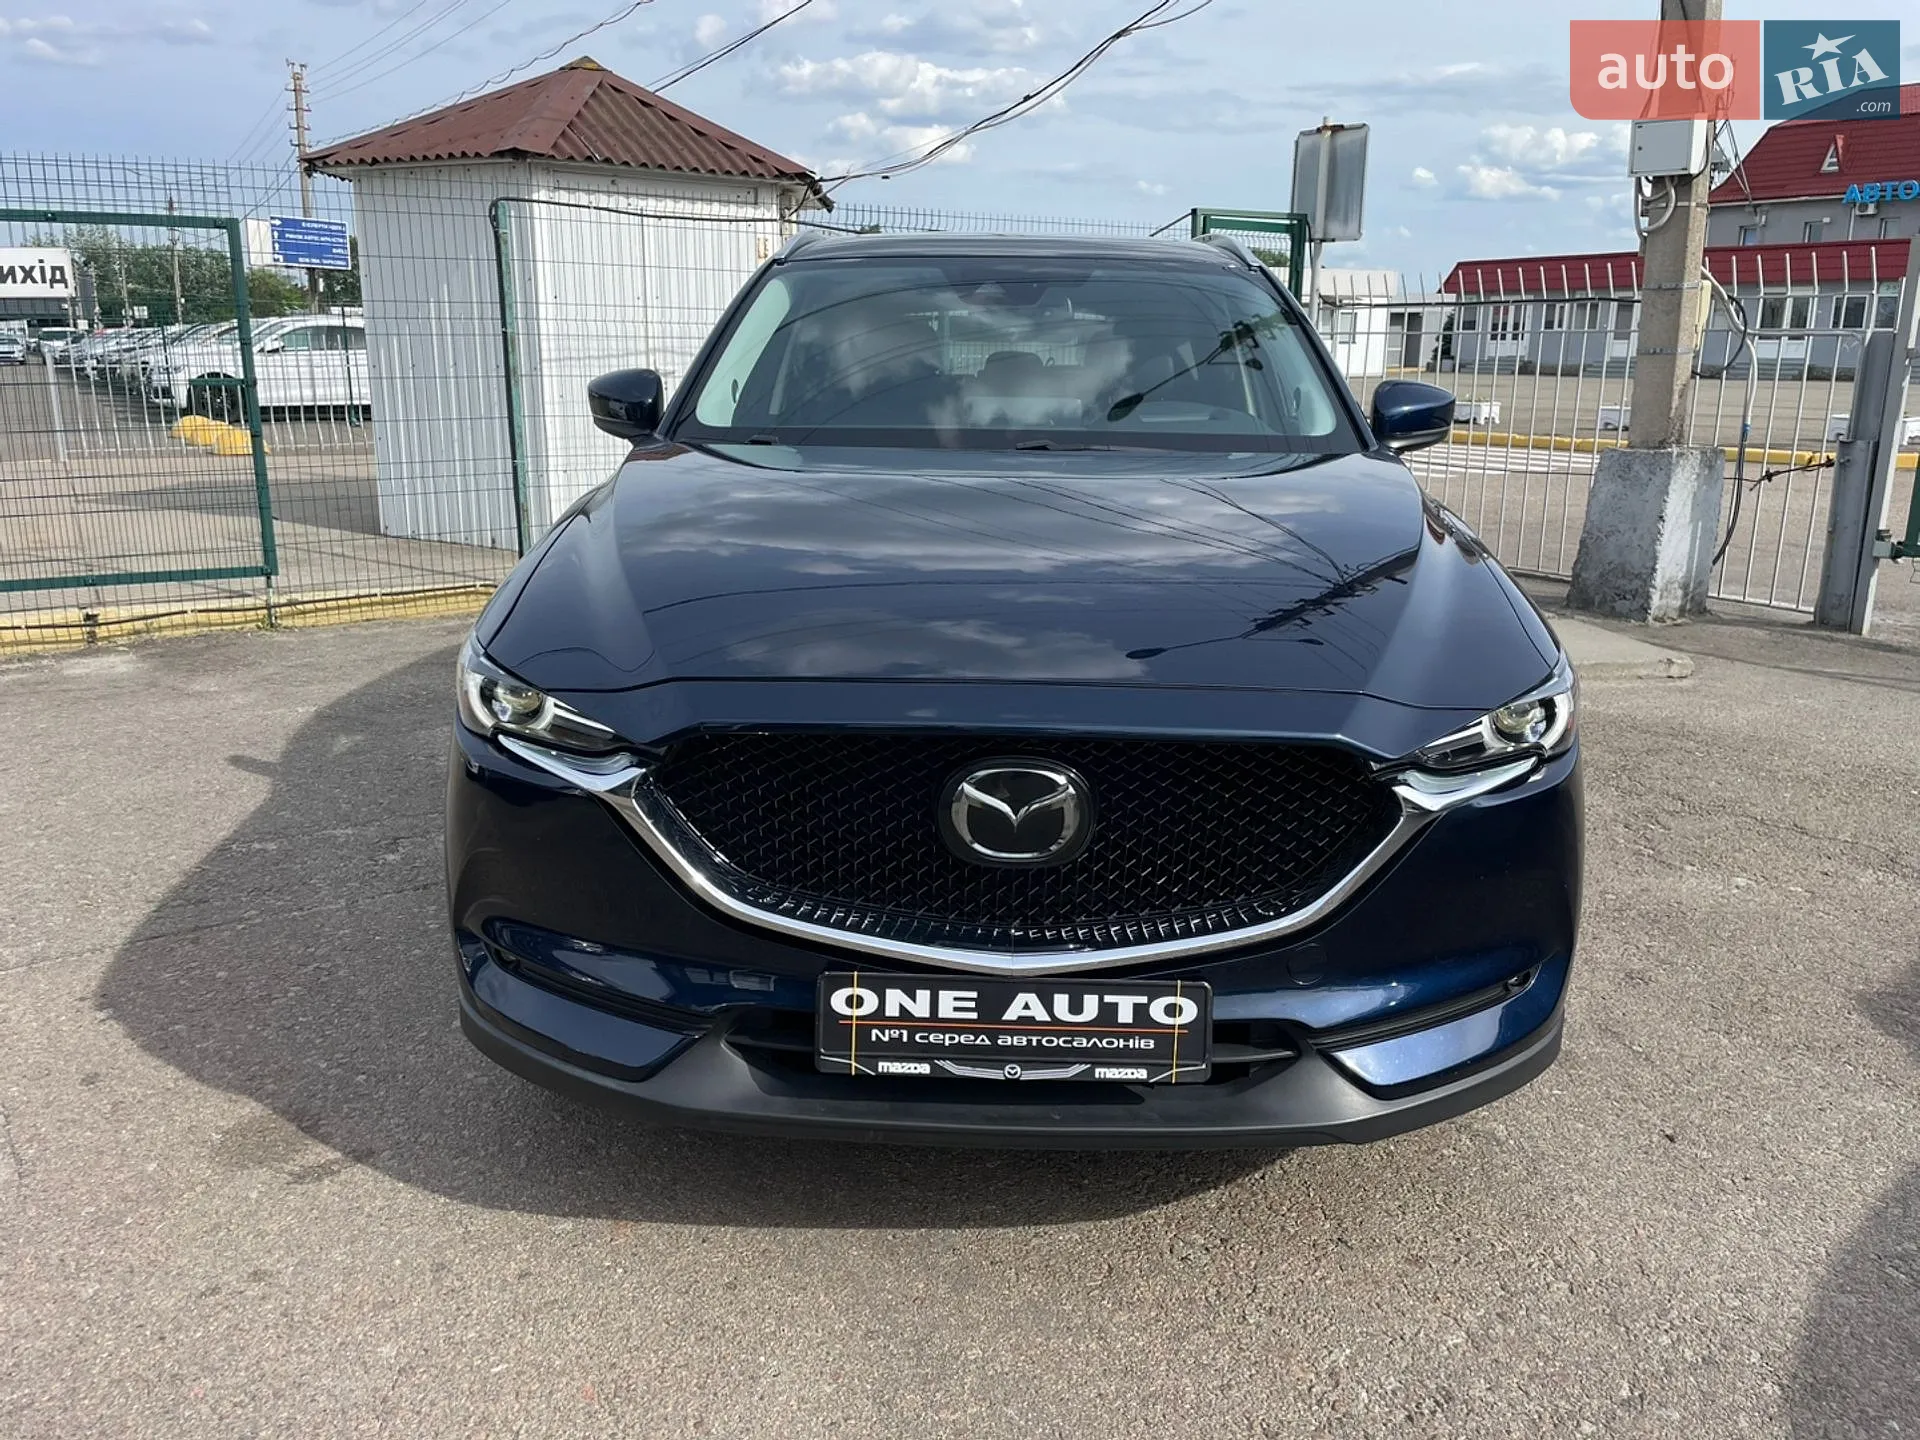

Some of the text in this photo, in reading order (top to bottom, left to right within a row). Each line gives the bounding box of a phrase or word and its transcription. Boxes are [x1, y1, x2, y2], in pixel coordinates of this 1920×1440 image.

[1842, 180, 1919, 204] АВТО
[830, 987, 1198, 1026] ONE AUTO
[914, 1031, 991, 1047] серед
[997, 1036, 1155, 1049] автосалонів
